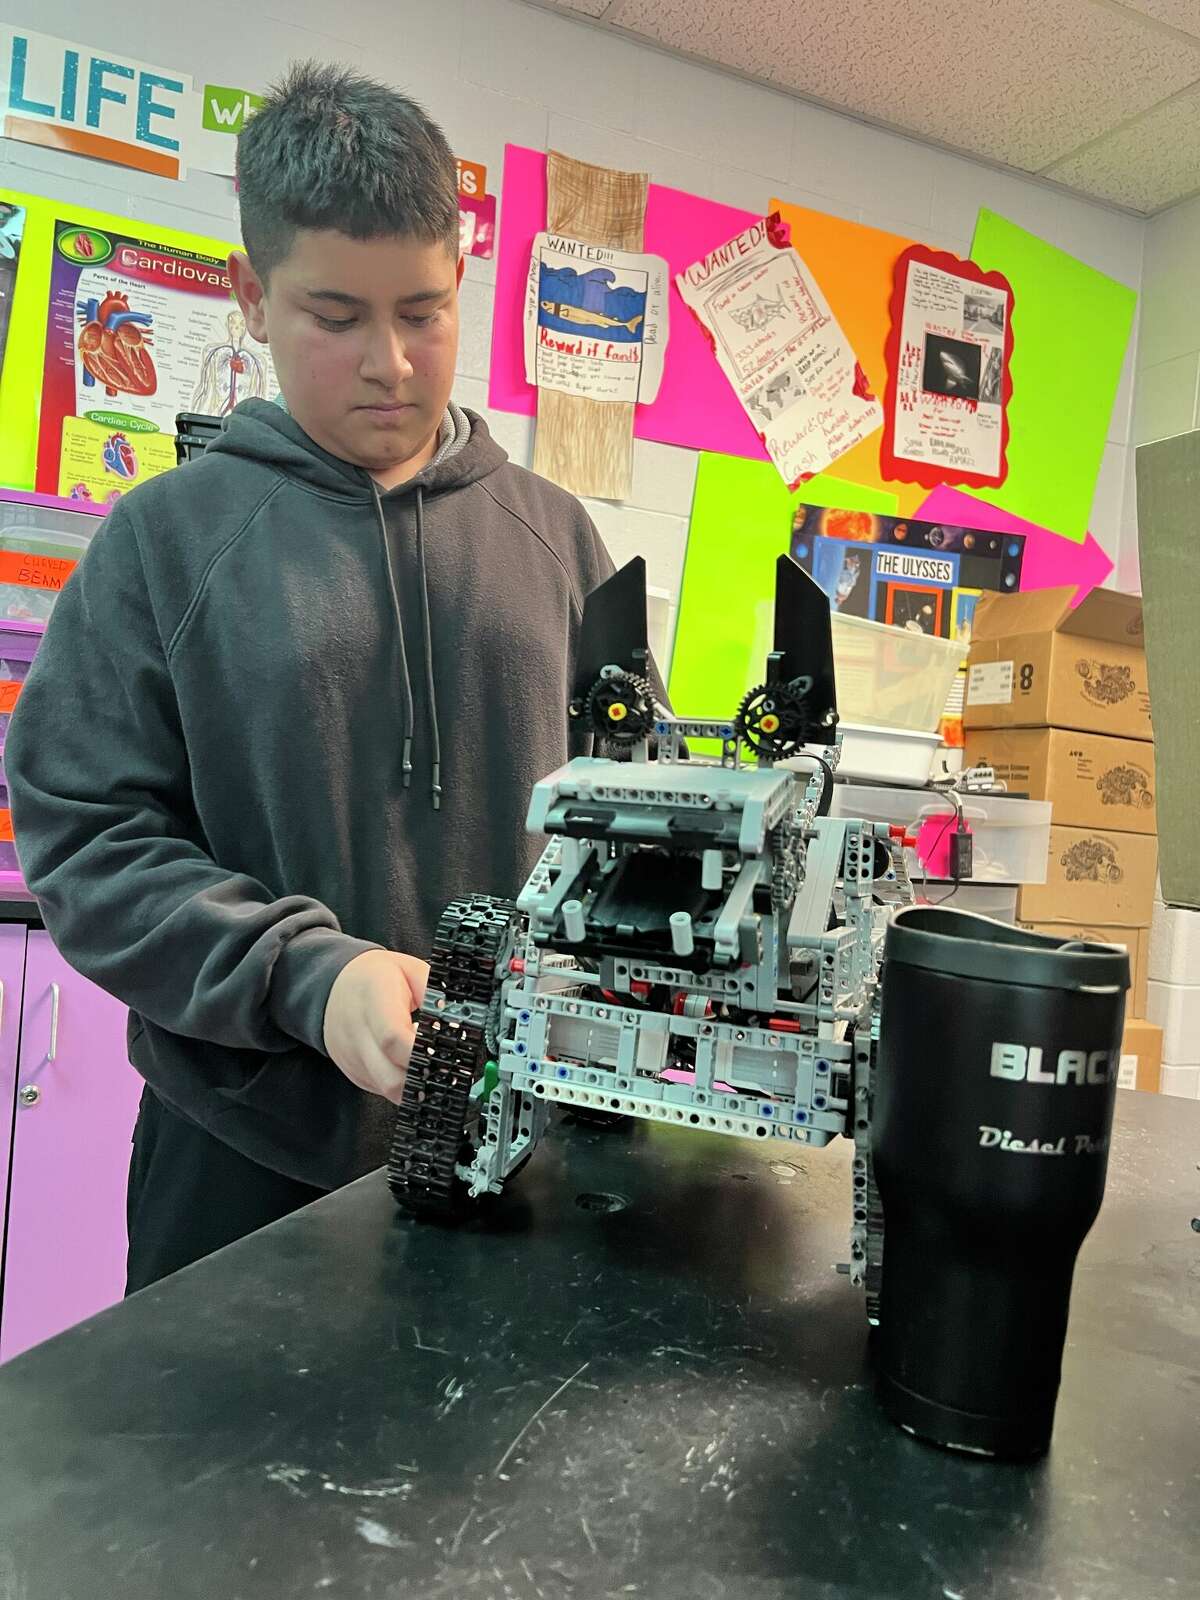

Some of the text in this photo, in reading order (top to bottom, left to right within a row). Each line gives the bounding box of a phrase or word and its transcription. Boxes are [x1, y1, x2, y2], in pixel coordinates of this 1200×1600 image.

[9, 36, 183, 152] LIFE
[138, 240, 219, 265] The Human Body
[546, 236, 614, 264] WANTED!!!
[683, 222, 766, 287] WANTED!
[121, 249, 233, 288] Cardiovas
[90, 412, 127, 427] Cardiac
[18, 568, 61, 588] BEAM
[877, 554, 951, 581] THE ULYSSES
[1020, 663, 1034, 690] 8
[990, 1042, 1110, 1086] BLAC
[978, 1125, 1065, 1155] Diesel
